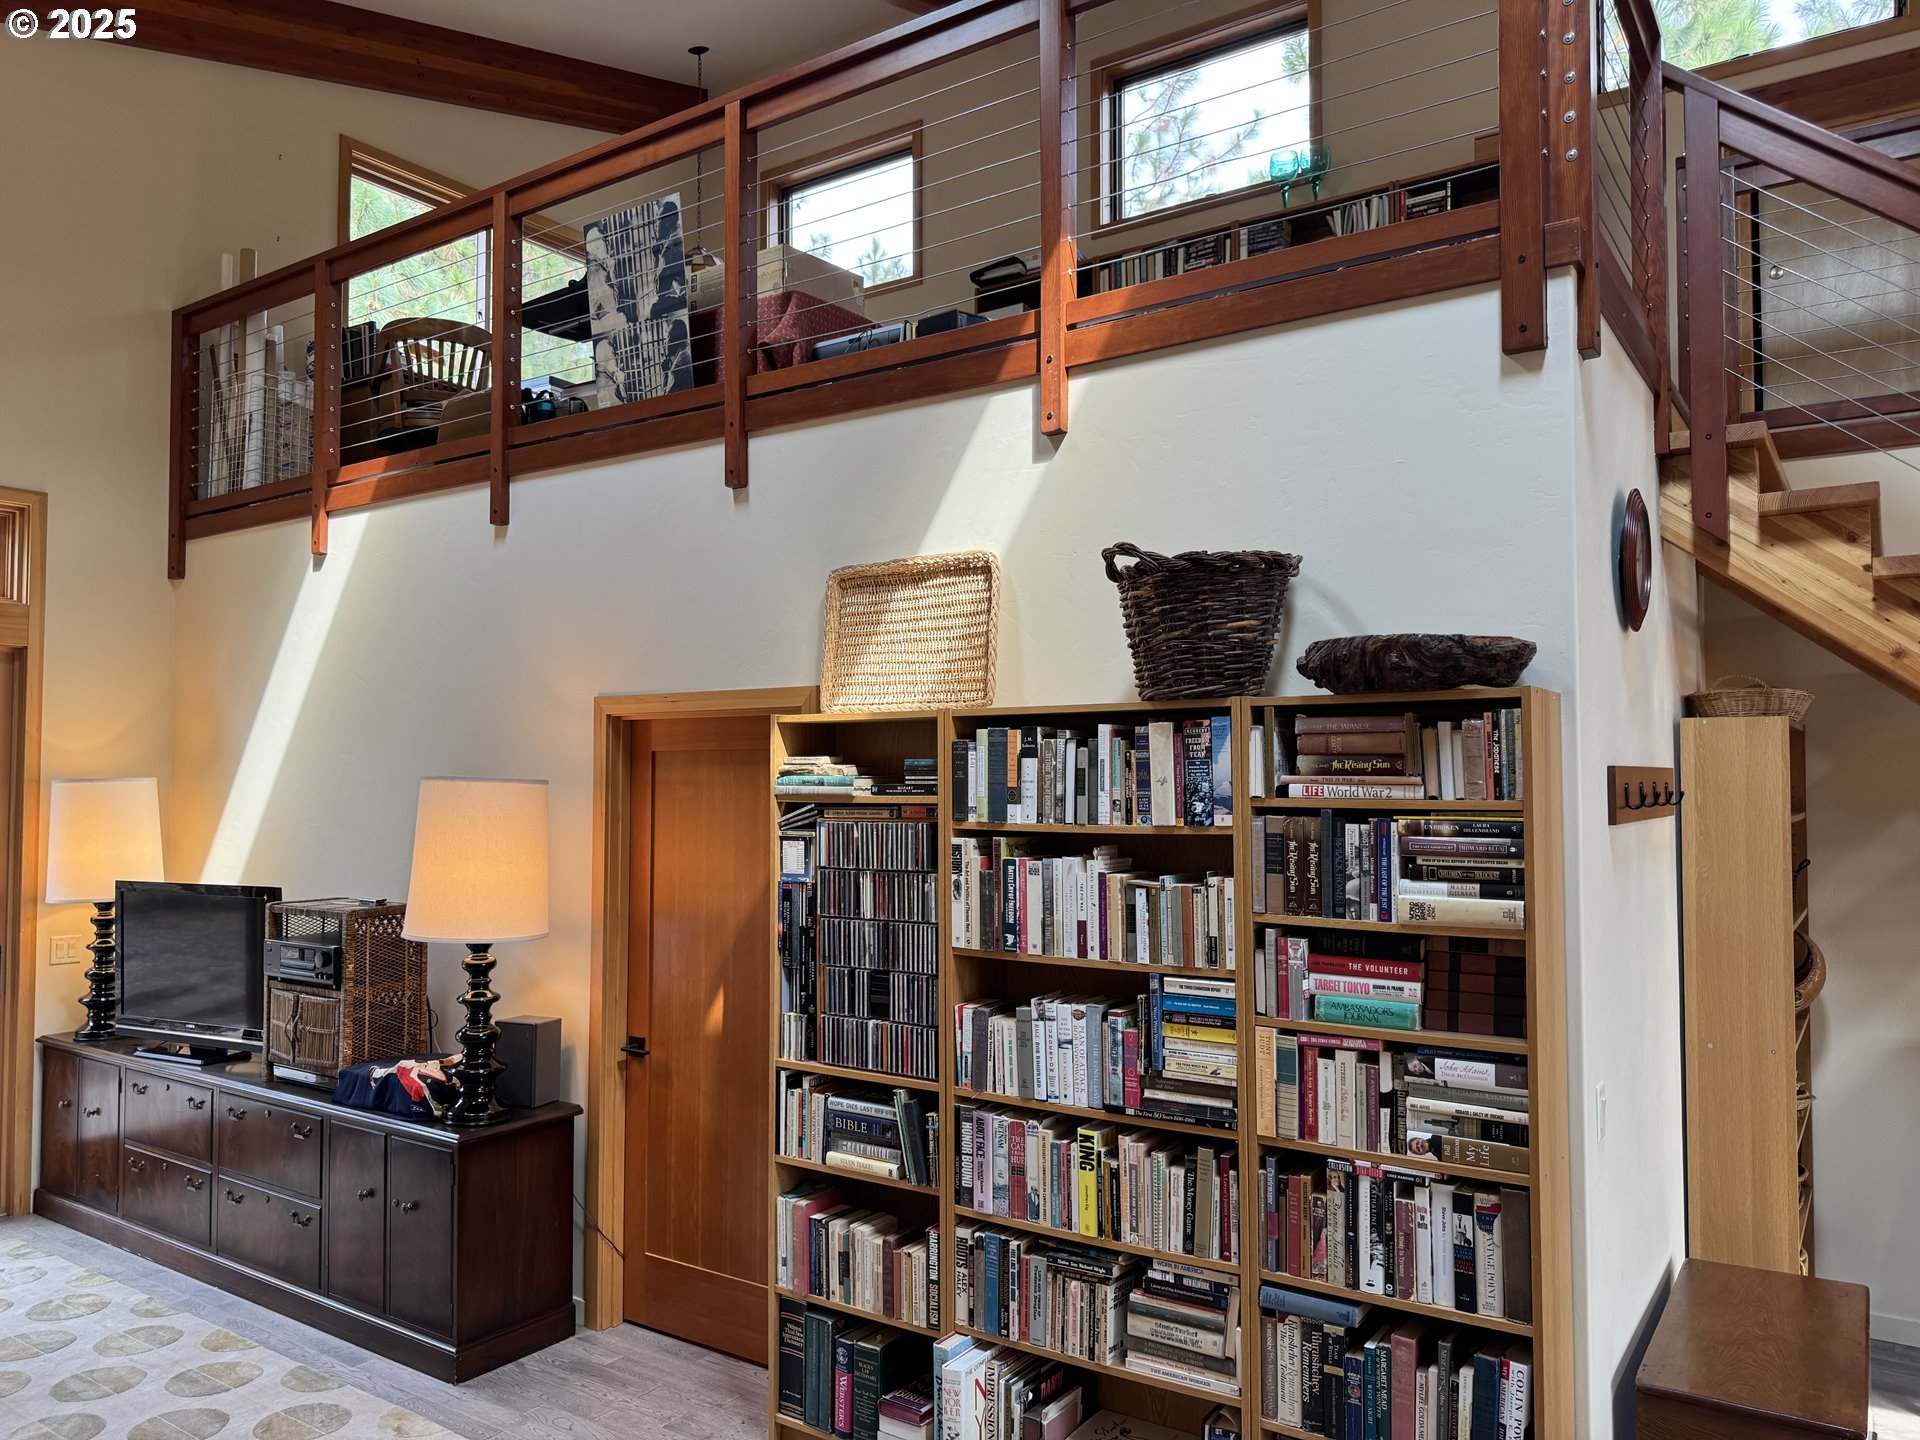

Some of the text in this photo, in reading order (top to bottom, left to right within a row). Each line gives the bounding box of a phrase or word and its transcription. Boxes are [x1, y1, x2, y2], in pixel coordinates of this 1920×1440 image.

[1302, 785, 1393, 798] LIFE World War 2
[1008, 866, 1016, 883] BATTLE
[1008, 884, 1016, 892] CRY
[1008, 901, 1016, 924] FREEDOM
[1314, 978, 1370, 995] TARGET TOKYO
[1365, 965, 1408, 975] VOLUNTEER
[1343, 1012, 1382, 1023] JOURNAL
[835, 1117, 868, 1134] BIBLE
[976, 1117, 986, 1159] ABOUT FACE
[961, 1122, 972, 1187] HONOR BOUND
[1079, 1133, 1095, 1171] KING
[956, 1237, 969, 1269] ROOTS
[929, 1232, 938, 1325] HARRINGTON SOCIALISM
[1283, 1320, 1299, 1369] Khrushchev
[1302, 1341, 1312, 1403] Remembers
[1311, 1331, 1322, 1395] Khrushchev
[838, 1375, 848, 1428] WEBSTER'S
[1514, 1370, 1525, 1412] COLIN
